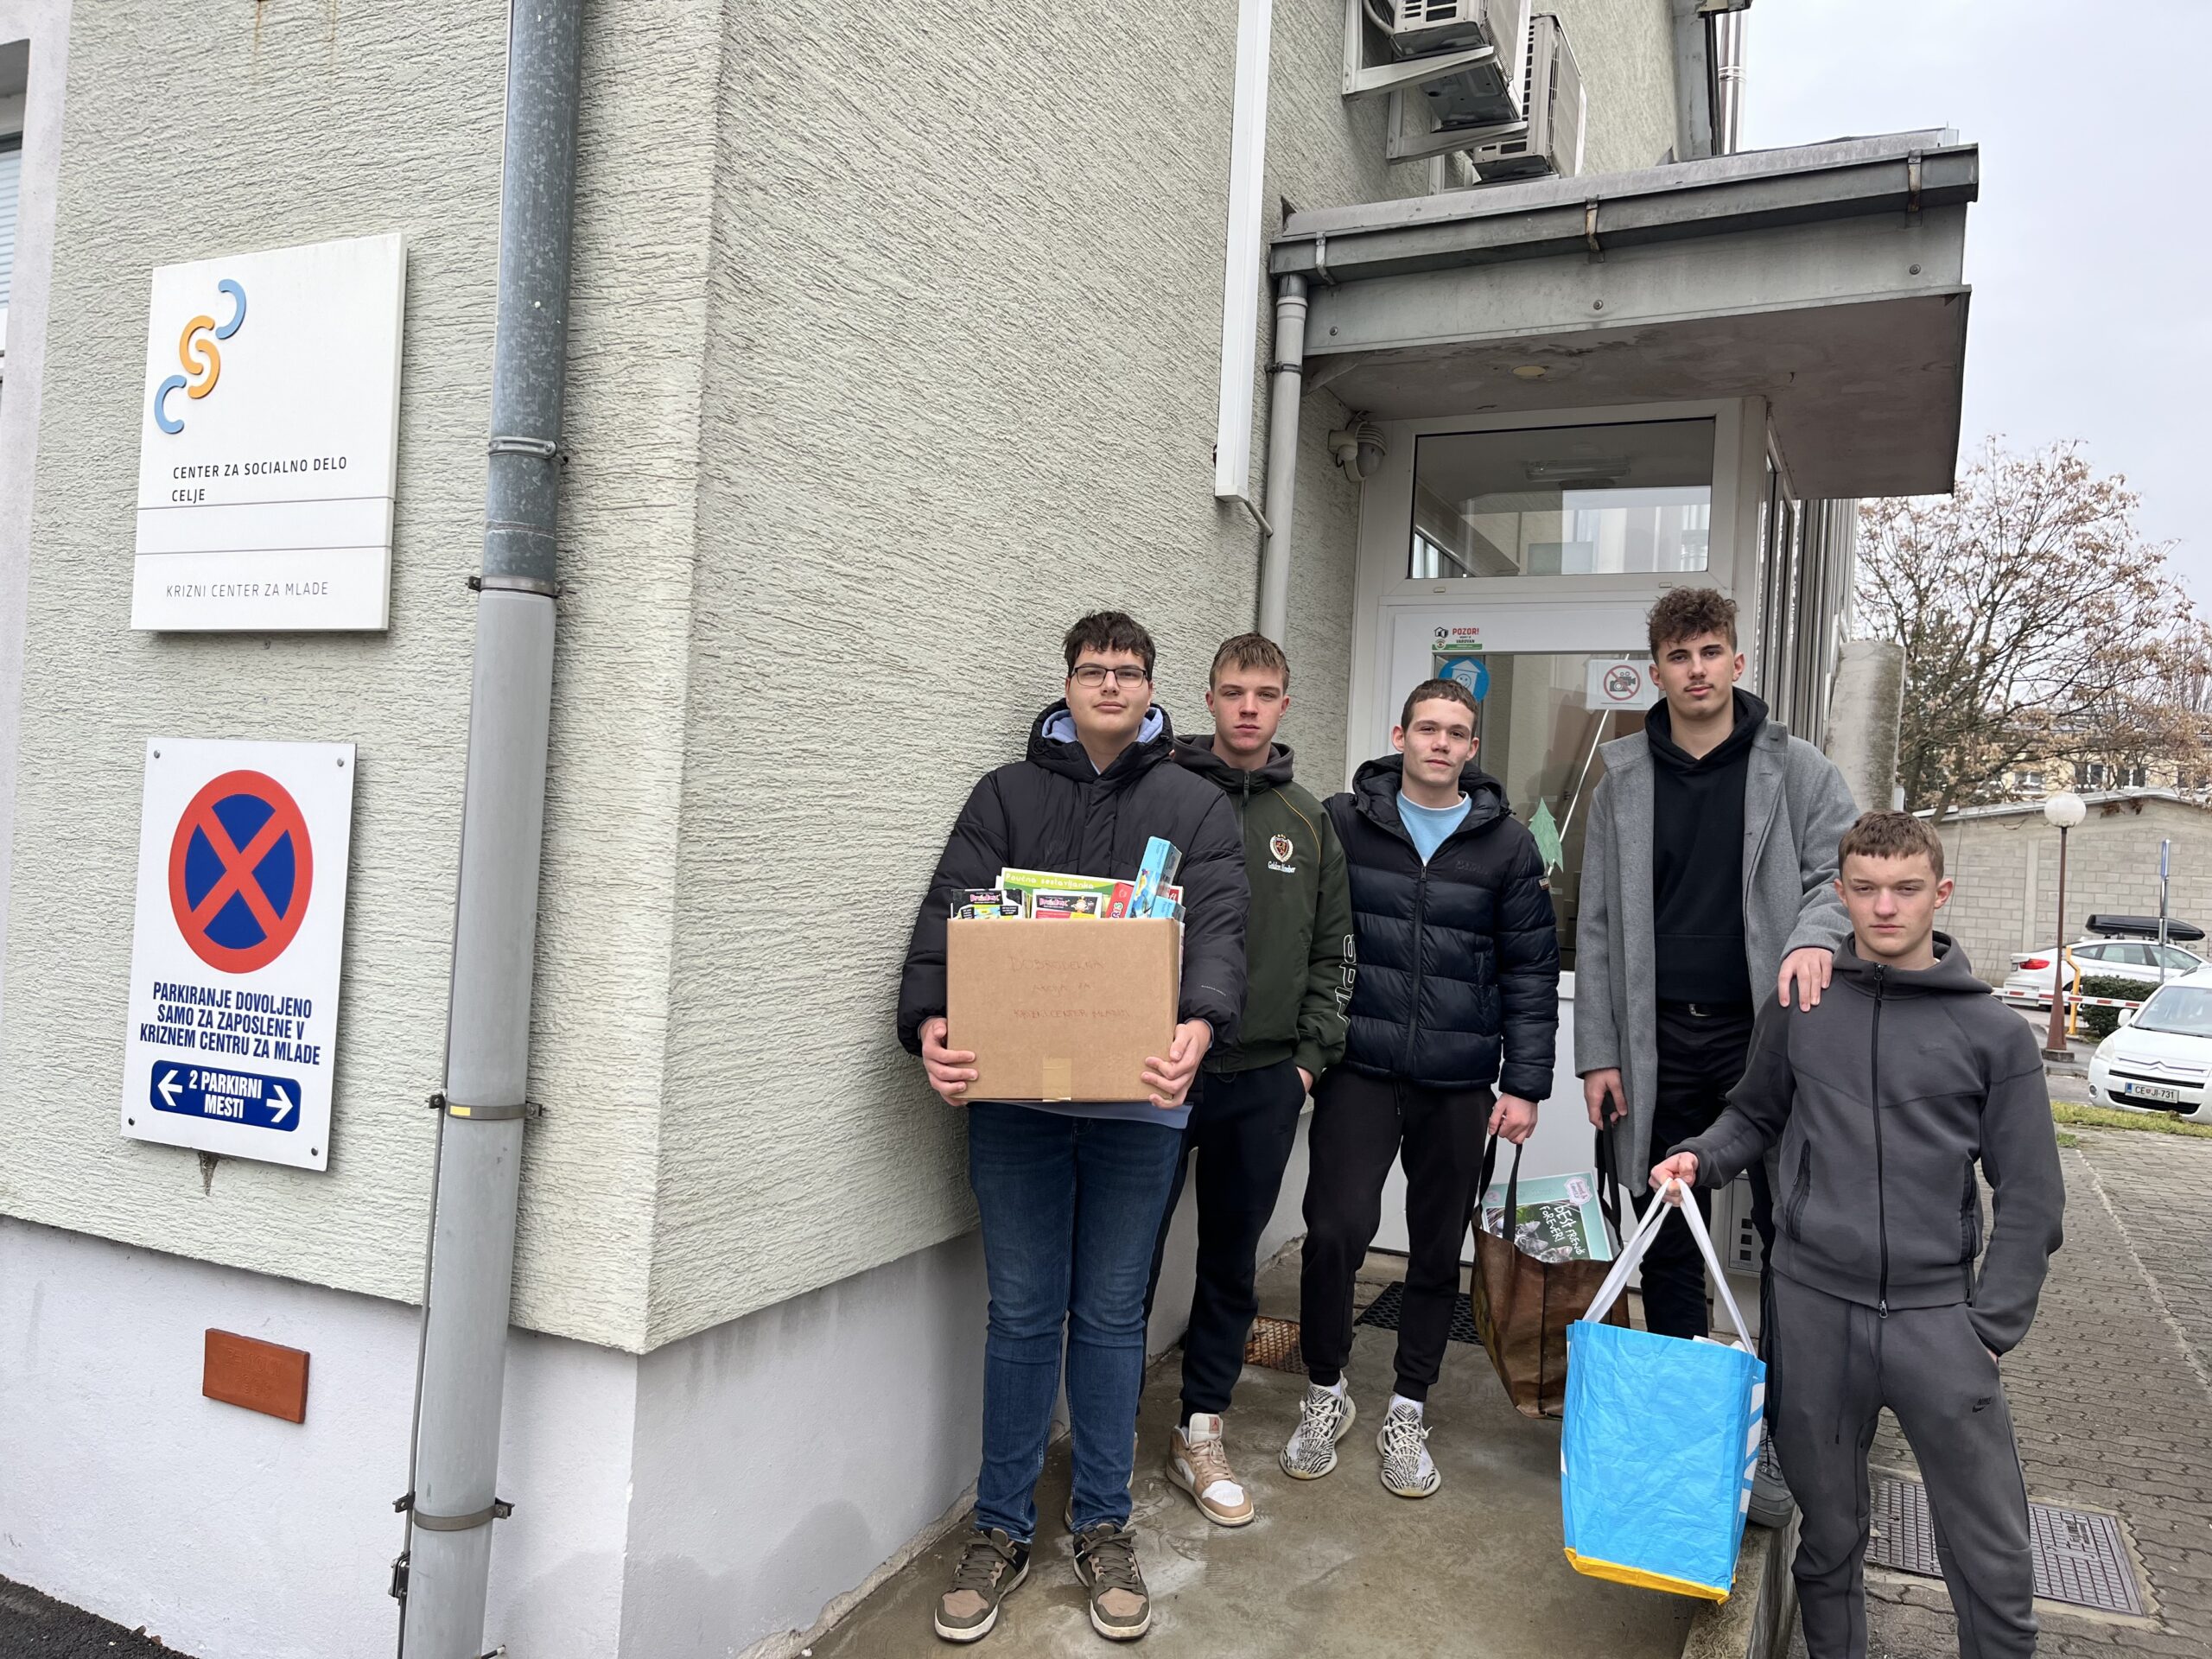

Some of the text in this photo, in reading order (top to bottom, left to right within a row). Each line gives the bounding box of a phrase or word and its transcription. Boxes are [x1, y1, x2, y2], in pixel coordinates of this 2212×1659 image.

[173, 456, 346, 479] CENTER ZA SOCIALNO DELO
[172, 488, 206, 504] CELJE
[166, 582, 328, 598] KRIZNI CENTER ZA MLADE
[1006, 873, 1037, 884] Poučna
[153, 982, 312, 1019] PARKIRANJE DOVOLJENO
[157, 1004, 305, 1040] SAMO ZA ZAPOSLENE V
[140, 1023, 321, 1065] KRIZNEM CENTRU ZA MLADE
[188, 1070, 263, 1099] 2 PARKIRNI
[2135, 1085, 2145, 1095] CE
[204, 1093, 245, 1119] MESTI
